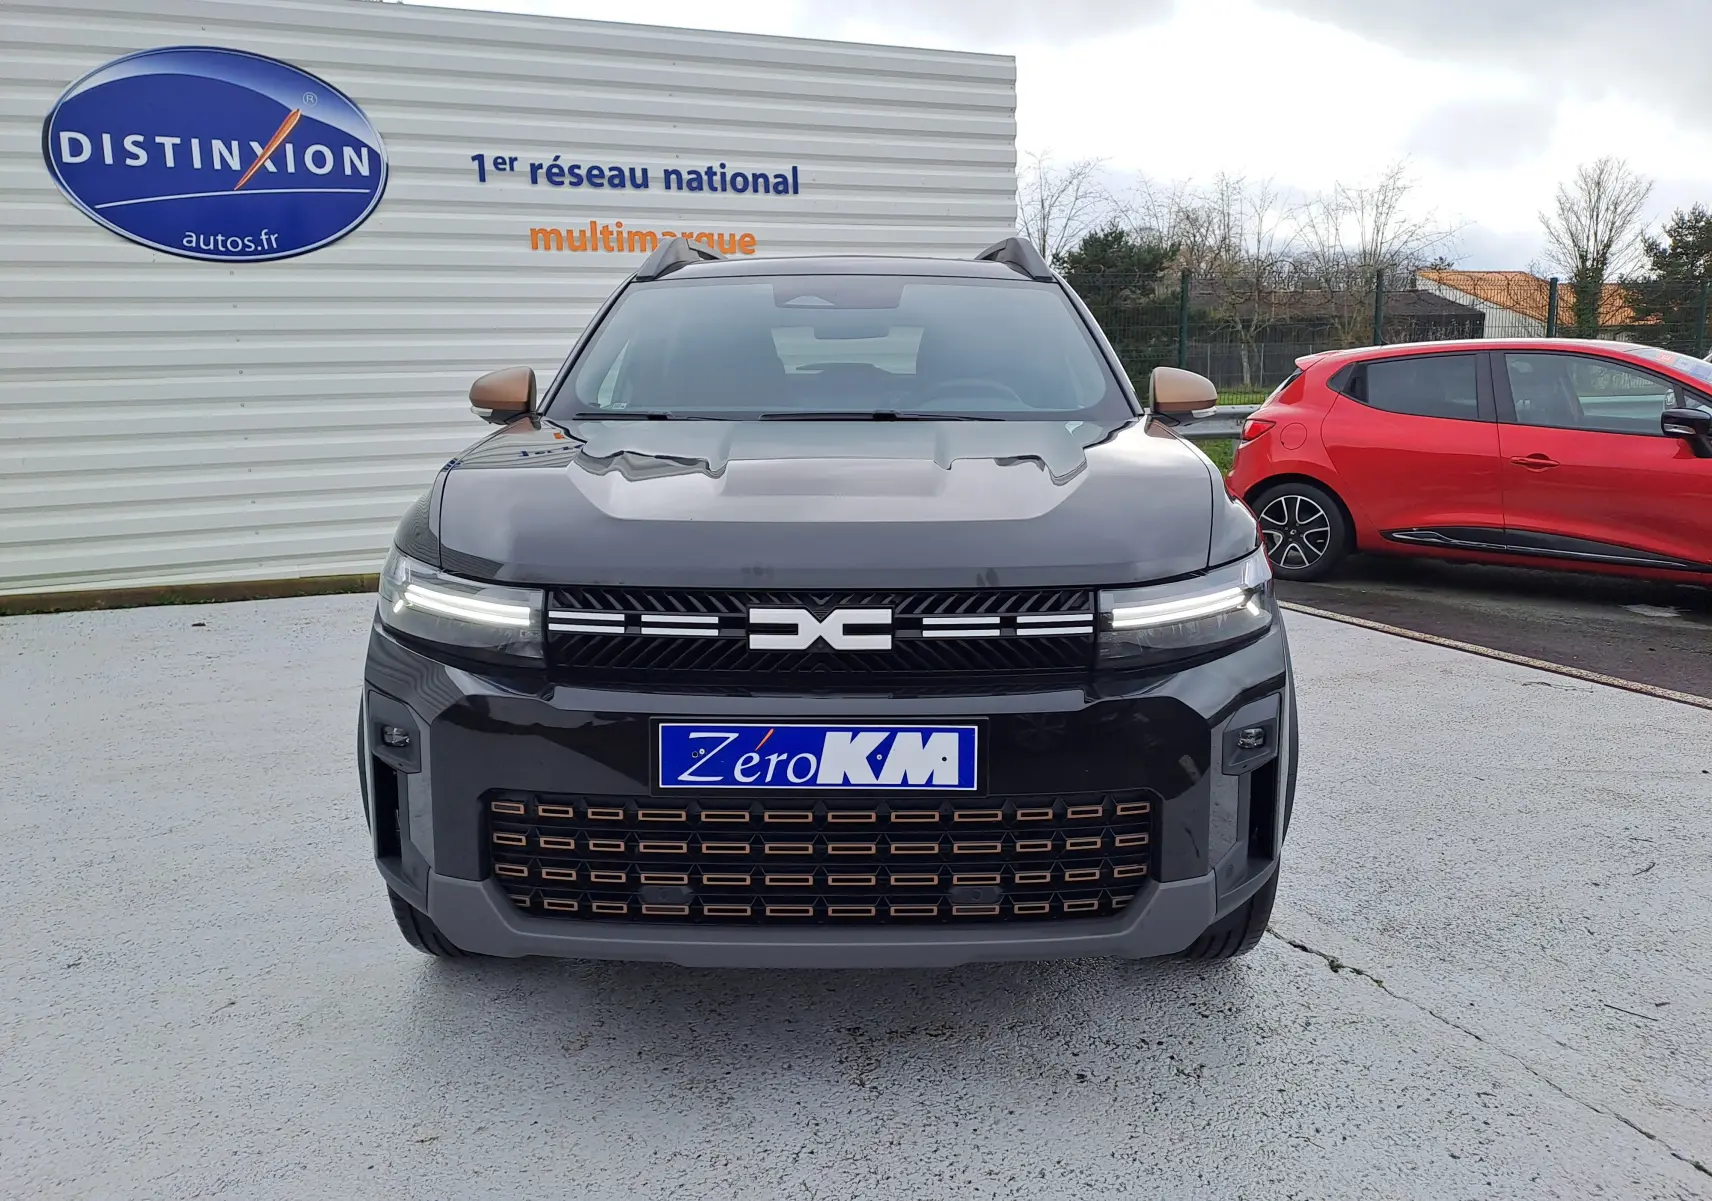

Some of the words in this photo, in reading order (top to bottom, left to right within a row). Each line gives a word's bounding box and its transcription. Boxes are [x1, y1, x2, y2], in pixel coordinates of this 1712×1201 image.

[59, 109, 370, 191] DISTINXION
[471, 153, 518, 183] 1er
[529, 155, 649, 188] réseau
[664, 163, 799, 195] national
[182, 229, 279, 252] autos.fr
[529, 220, 757, 255] multimque
